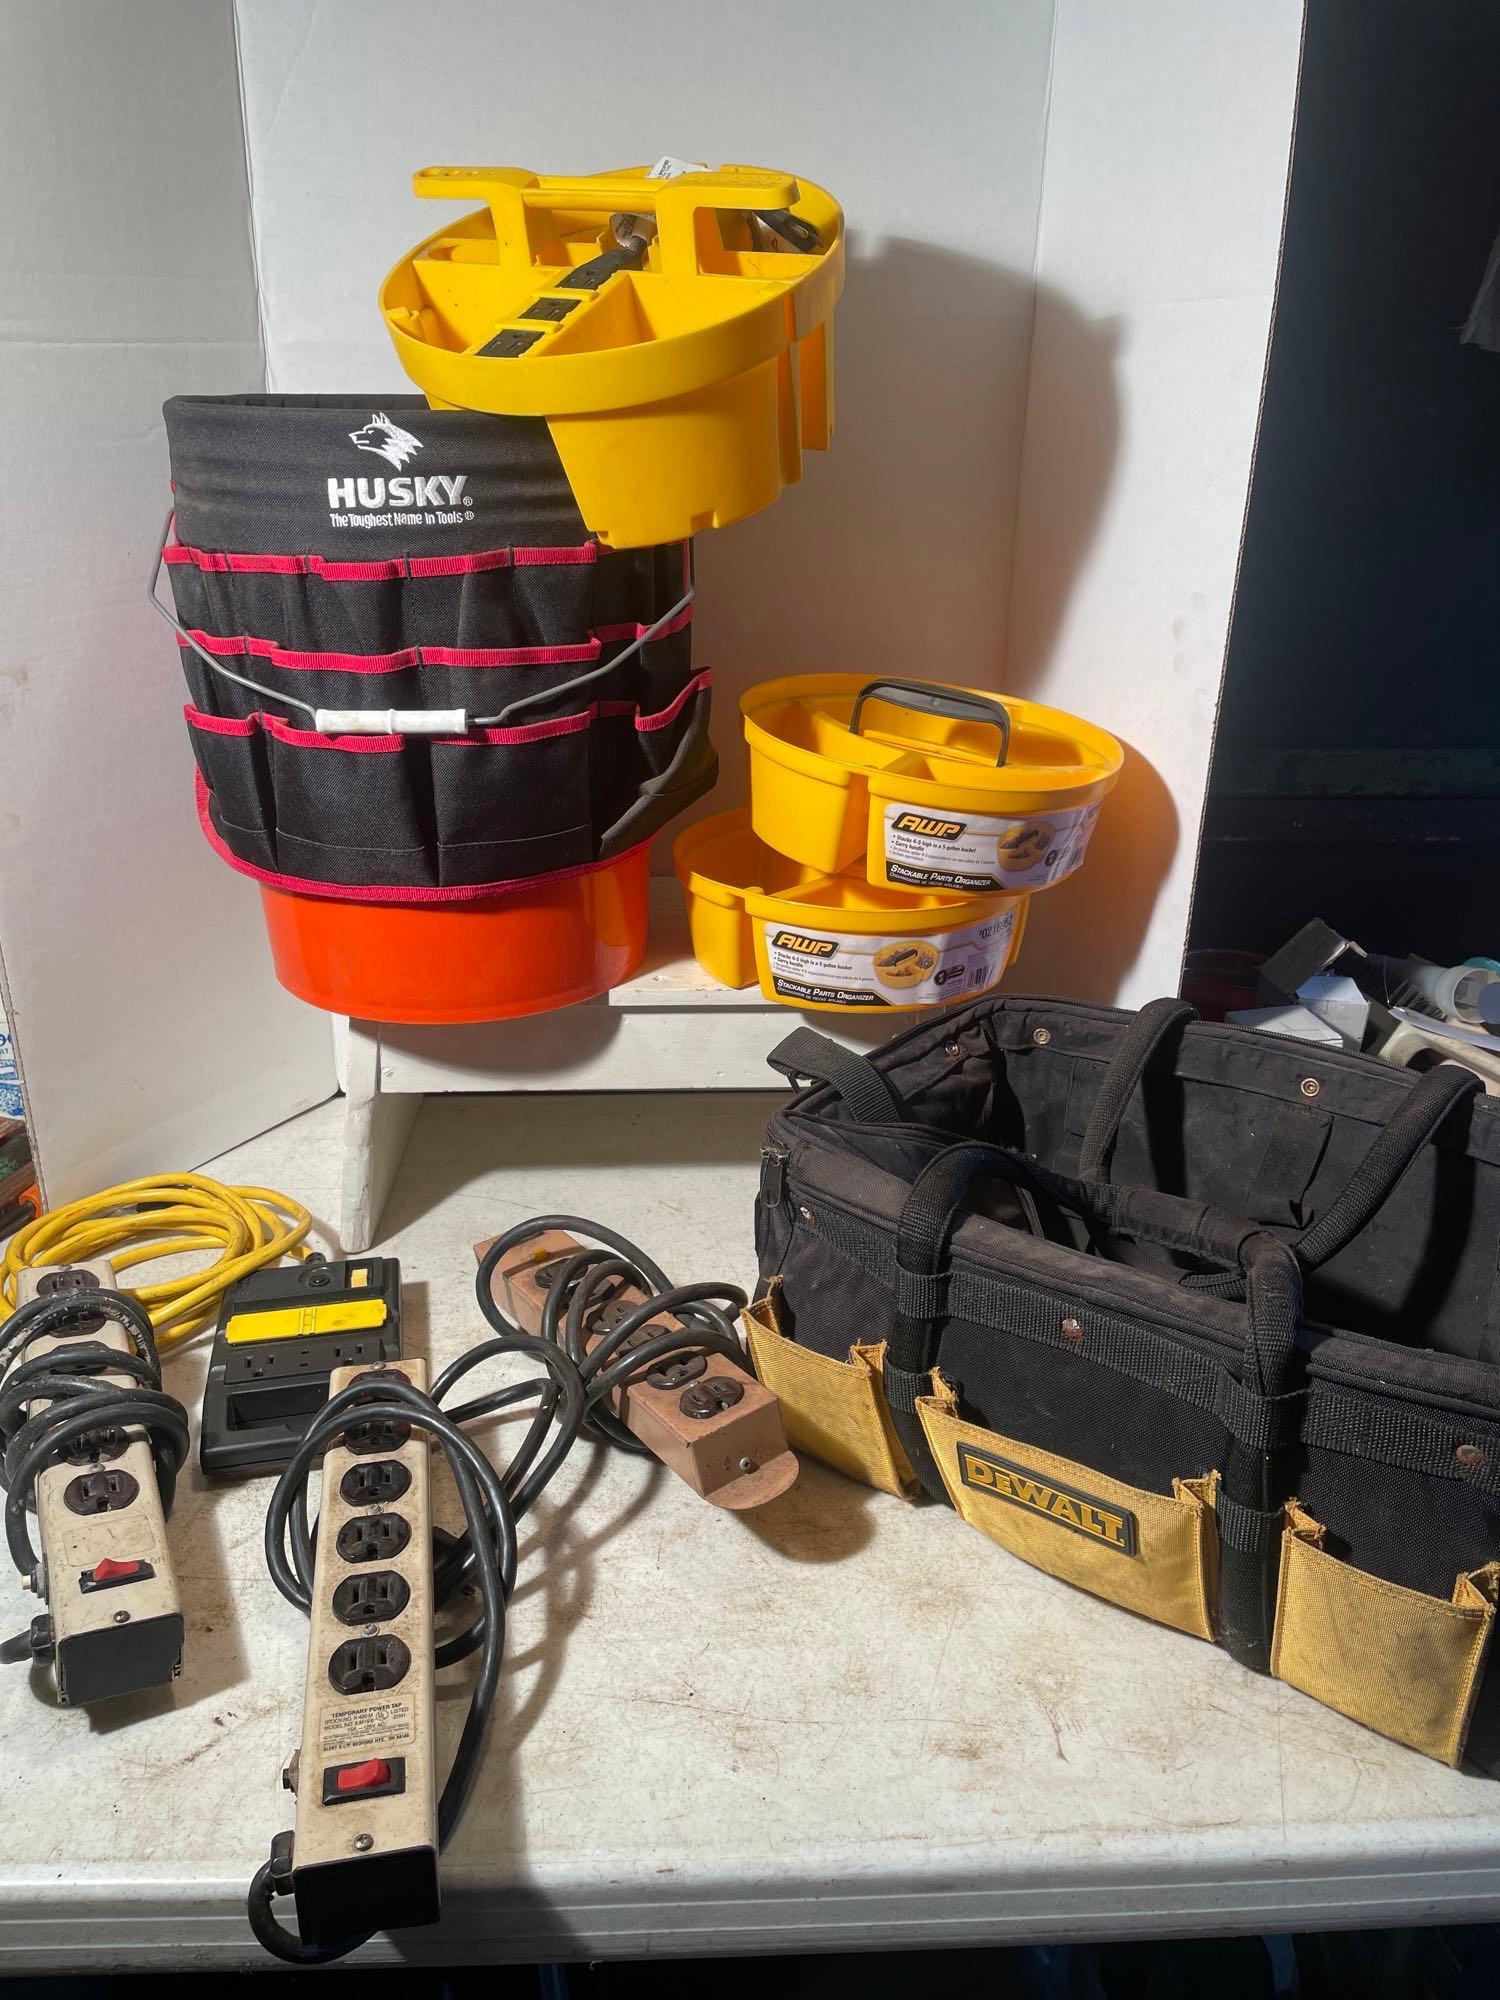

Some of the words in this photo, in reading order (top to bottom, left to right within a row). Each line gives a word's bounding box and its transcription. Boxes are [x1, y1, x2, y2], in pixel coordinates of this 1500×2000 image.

[328, 475, 468, 508] HUSKY
[329, 513, 348, 527] The
[348, 512, 394, 529] Toughest
[394, 512, 422, 526] Name
[436, 511, 464, 524] Tools
[897, 815, 961, 836] AWP
[930, 872, 953, 882] PARTS
[776, 933, 833, 954] AWP
[813, 988, 835, 997] PARTS
[966, 1458, 1124, 1542] DEWALT
[369, 1704, 390, 1712] POWER
